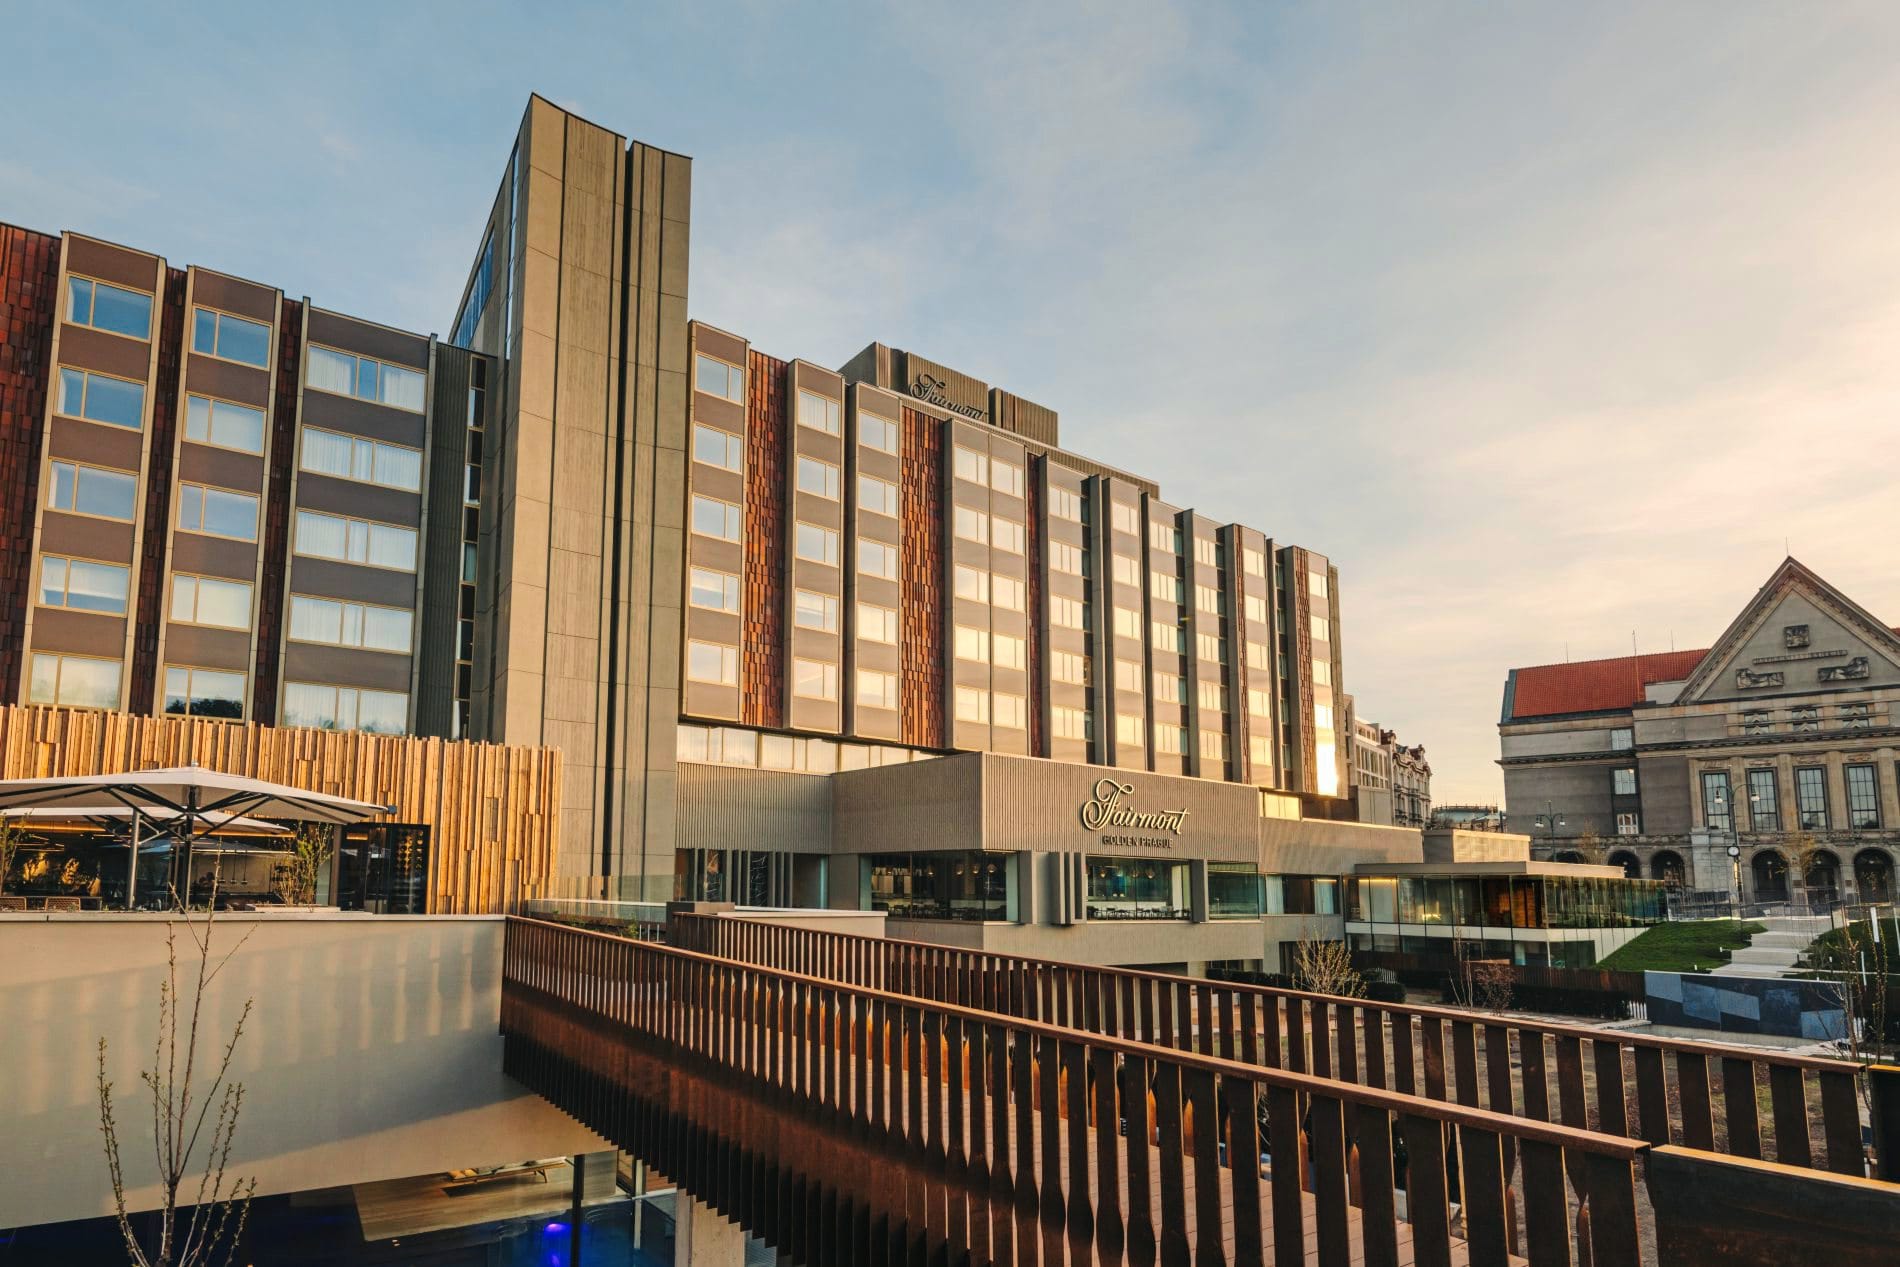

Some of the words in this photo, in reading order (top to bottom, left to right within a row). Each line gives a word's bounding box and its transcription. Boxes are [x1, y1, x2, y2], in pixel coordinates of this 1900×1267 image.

[910, 373, 988, 420] Fairmont
[1082, 778, 1190, 835] Fairmont
[1102, 834, 1137, 847] GOLDEN
[1139, 836, 1173, 849] PRAGUE
